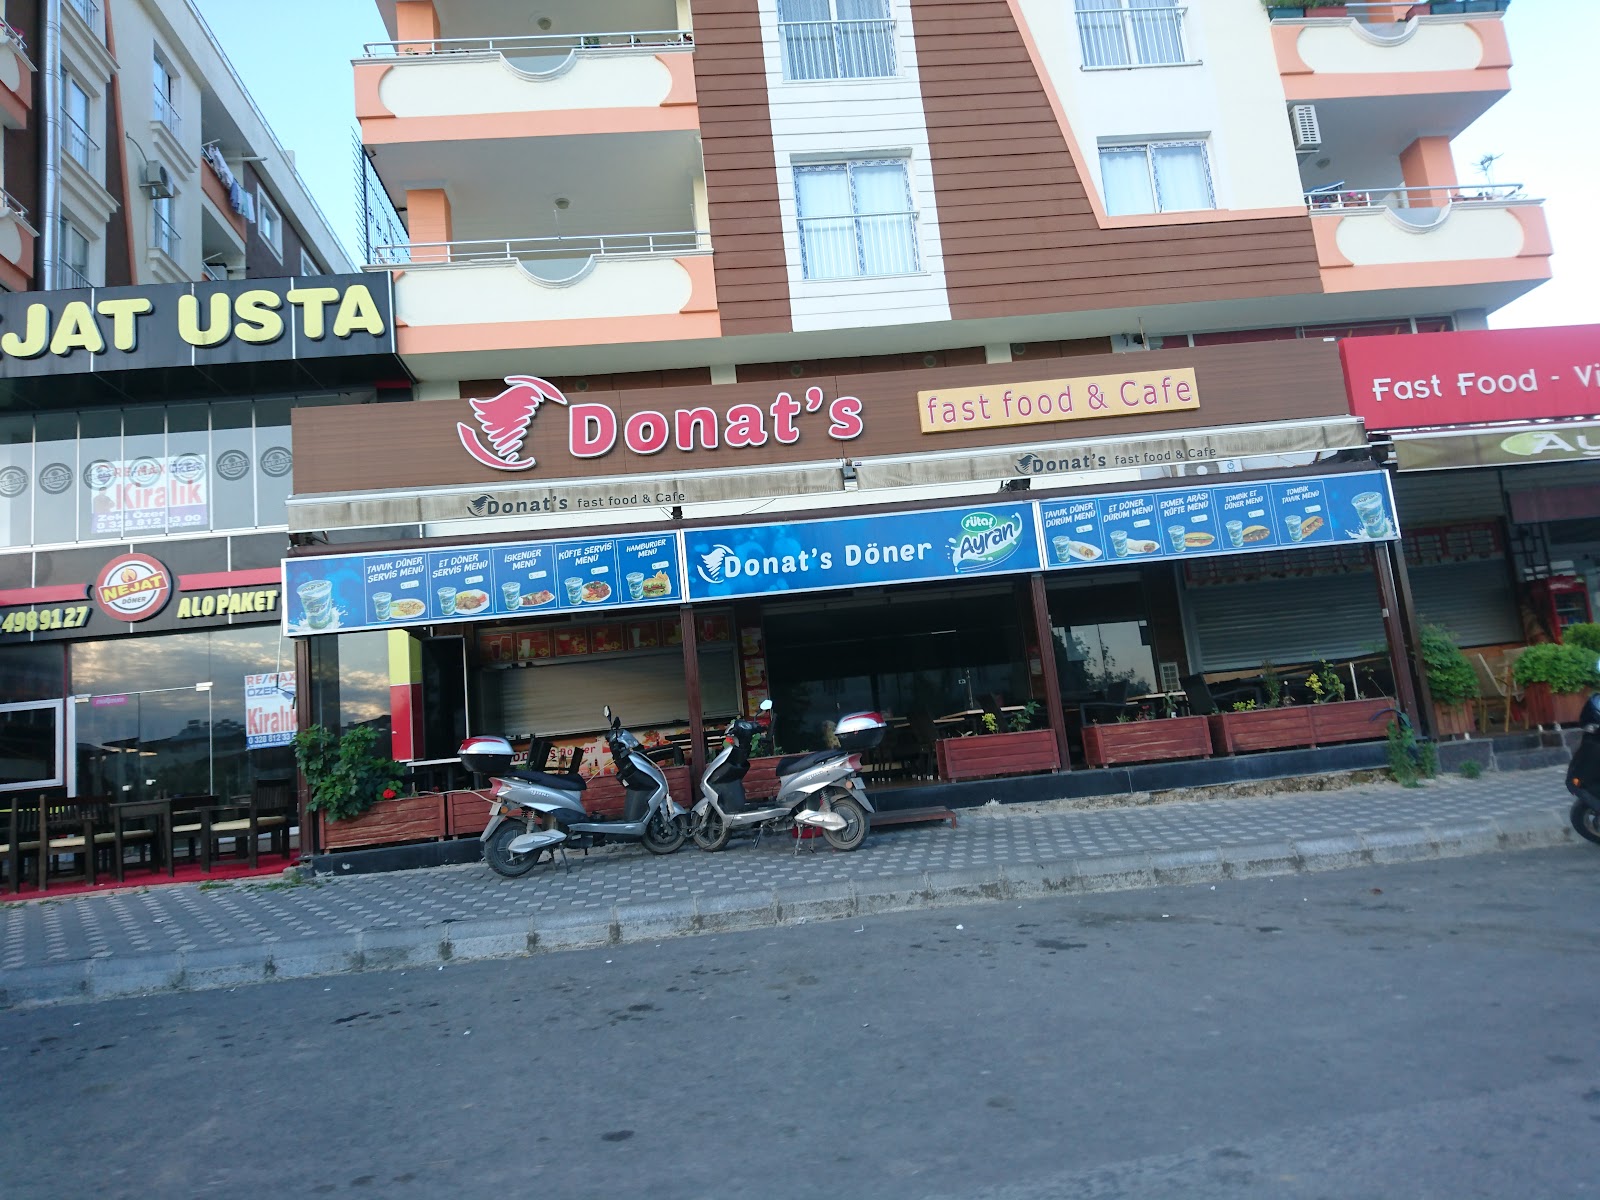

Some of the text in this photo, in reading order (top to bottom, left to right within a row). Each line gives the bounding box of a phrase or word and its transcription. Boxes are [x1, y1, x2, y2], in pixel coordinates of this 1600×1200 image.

[178, 284, 384, 346] USTA
[1372, 374, 1443, 402] Fast
[1456, 368, 1538, 396] Food
[926, 376, 1192, 425] fast food & Cafe
[568, 386, 864, 459] Donat's
[1032, 447, 1216, 474] Donat's fast food & Cafe
[487, 491, 685, 515] Donat's fast food & Cafe
[1160, 498, 1184, 509] EKMEK
[1249, 489, 1258, 497] ET
[1044, 507, 1067, 519] TAVUK
[1108, 504, 1117, 513] ET
[626, 538, 666, 553] HAMBURGER
[960, 523, 1014, 559] Ayran
[367, 561, 393, 575] TAVUK
[438, 558, 449, 568] ET
[724, 541, 933, 578] Donat's Döner
[103, 575, 163, 603] NEJAT
[216, 590, 278, 615] PAKET
